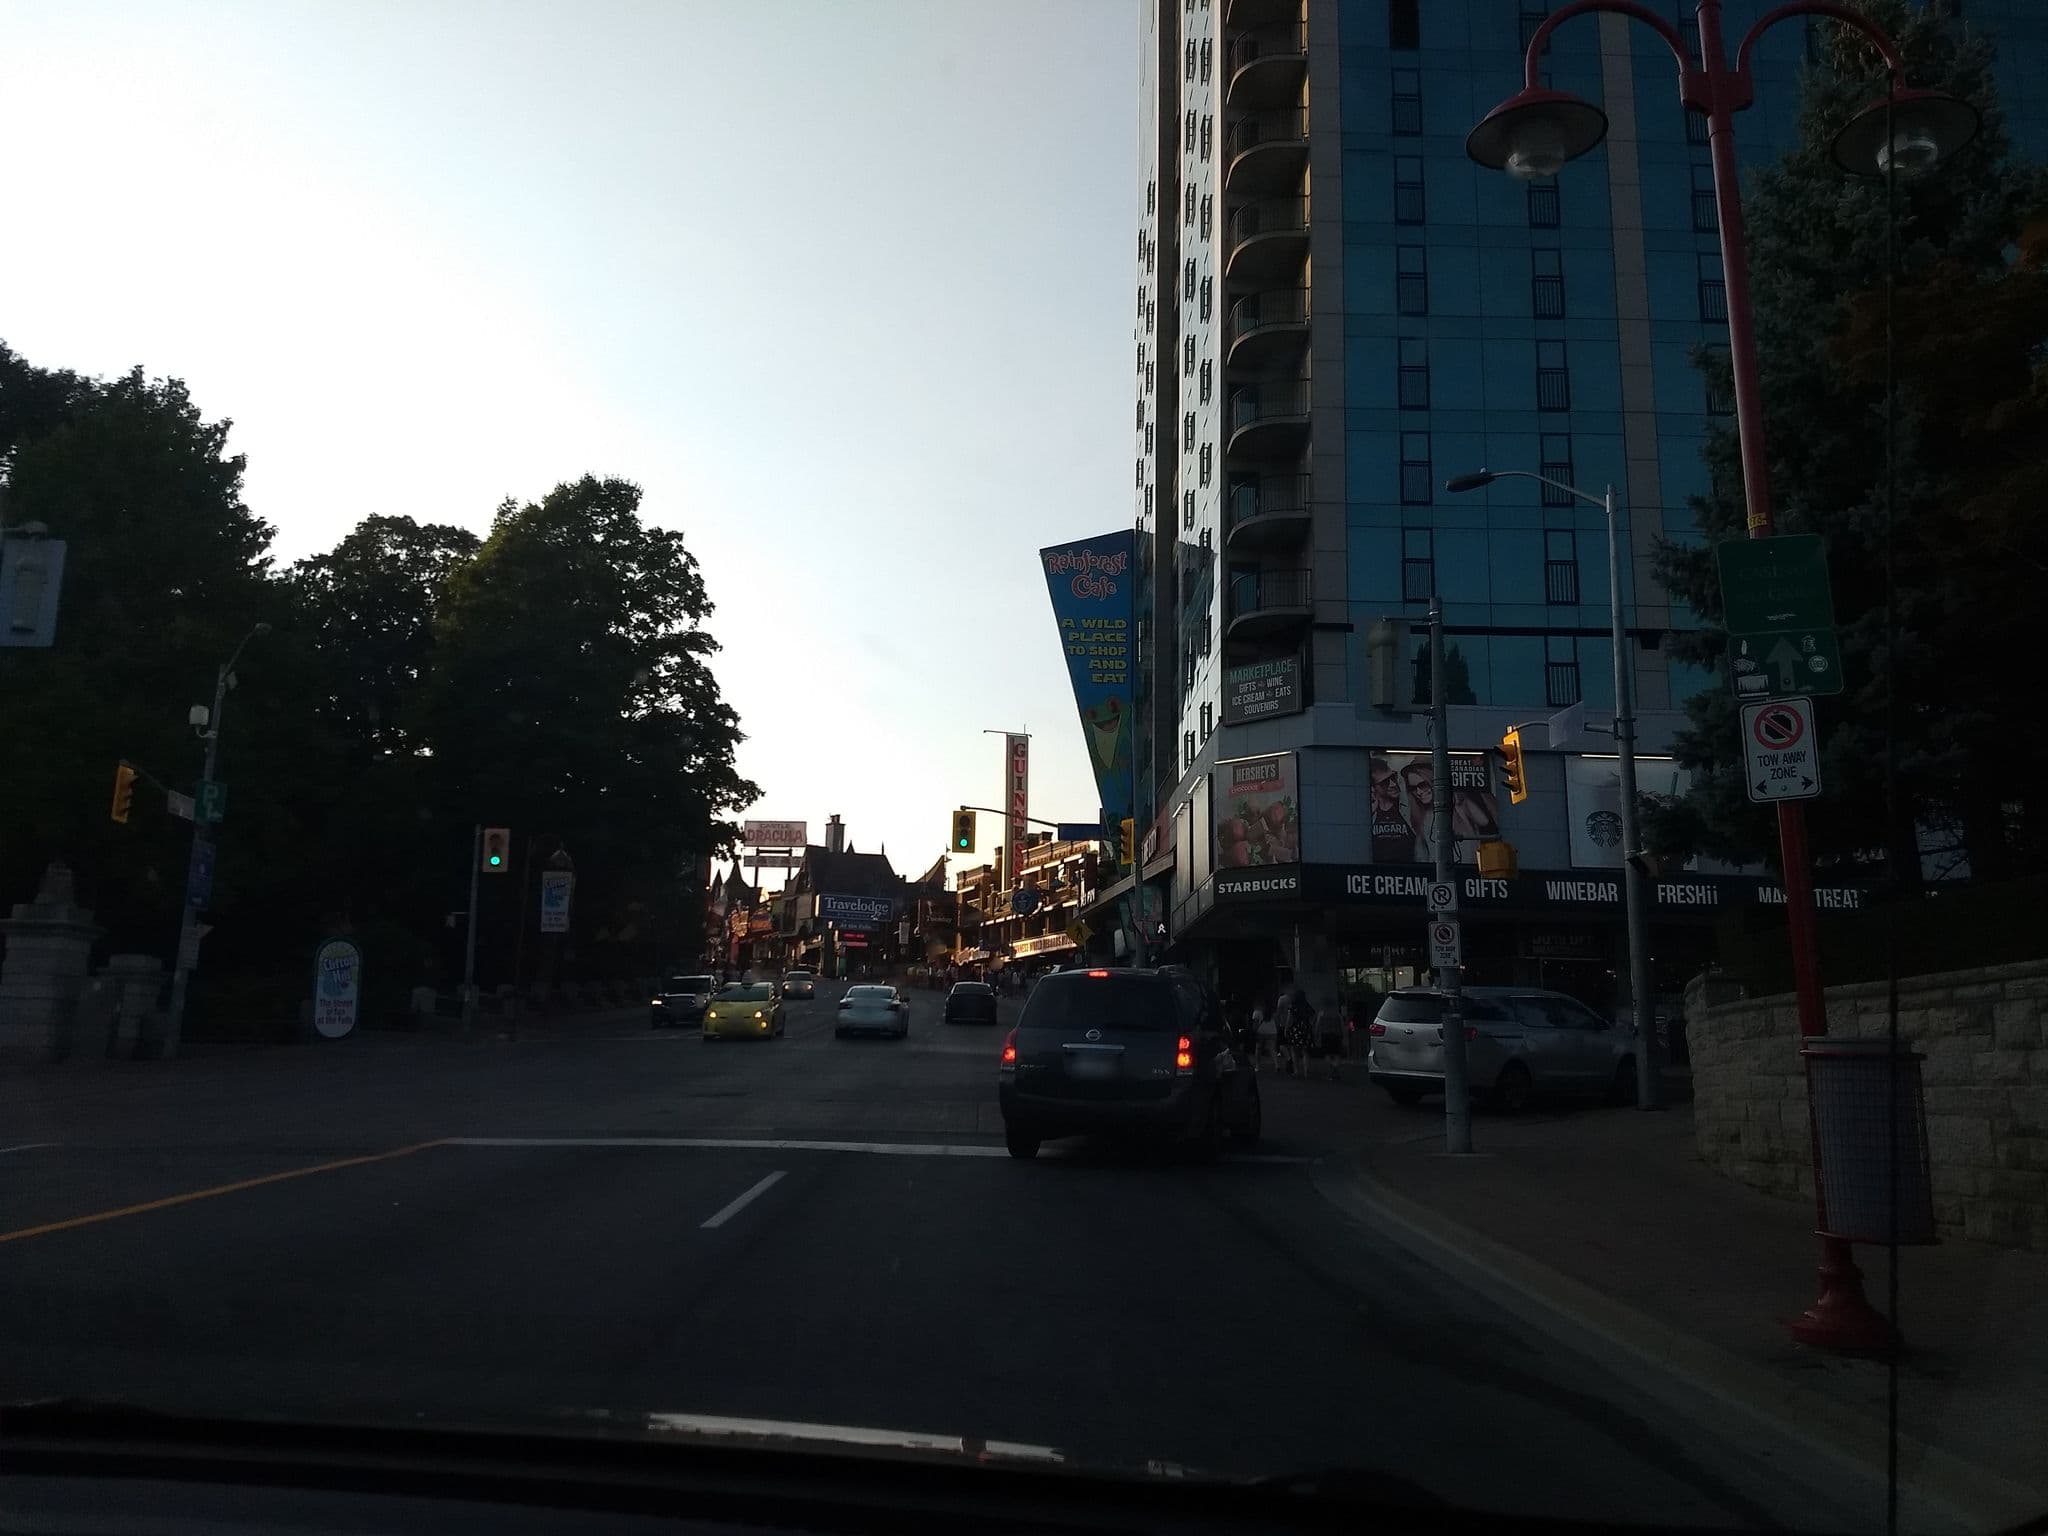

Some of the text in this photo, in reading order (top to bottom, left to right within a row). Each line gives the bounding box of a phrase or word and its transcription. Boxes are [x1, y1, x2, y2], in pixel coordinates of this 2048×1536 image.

[1046, 550, 1127, 575] Rainforest
[1062, 618, 1127, 629] A WILD
[1068, 632, 1127, 642] PLACE
[1068, 646, 1127, 656] TO SHOP
[1088, 659, 1127, 669] AND
[1230, 659, 1293, 683] MARKETPLACE
[1092, 673, 1127, 683] EAT
[1239, 676, 1283, 693] GIFTS WINE
[1232, 686, 1292, 706] ICE CREAM EATS
[1244, 700, 1279, 715] SOUVENIRS
[1757, 751, 1806, 767] TOW AWAY
[1235, 763, 1277, 782] HERSHEY'S
[1451, 772, 1485, 788] GIFTS
[1770, 766, 1797, 779] ZONE
[747, 829, 803, 843] DRACULA
[1217, 877, 1297, 894] STARBUCKS
[1347, 874, 1429, 896] ICE CREAM
[1465, 878, 1509, 899] GIFTS
[1545, 880, 1619, 902] WINEBAR
[824, 897, 889, 920] Travelodge
